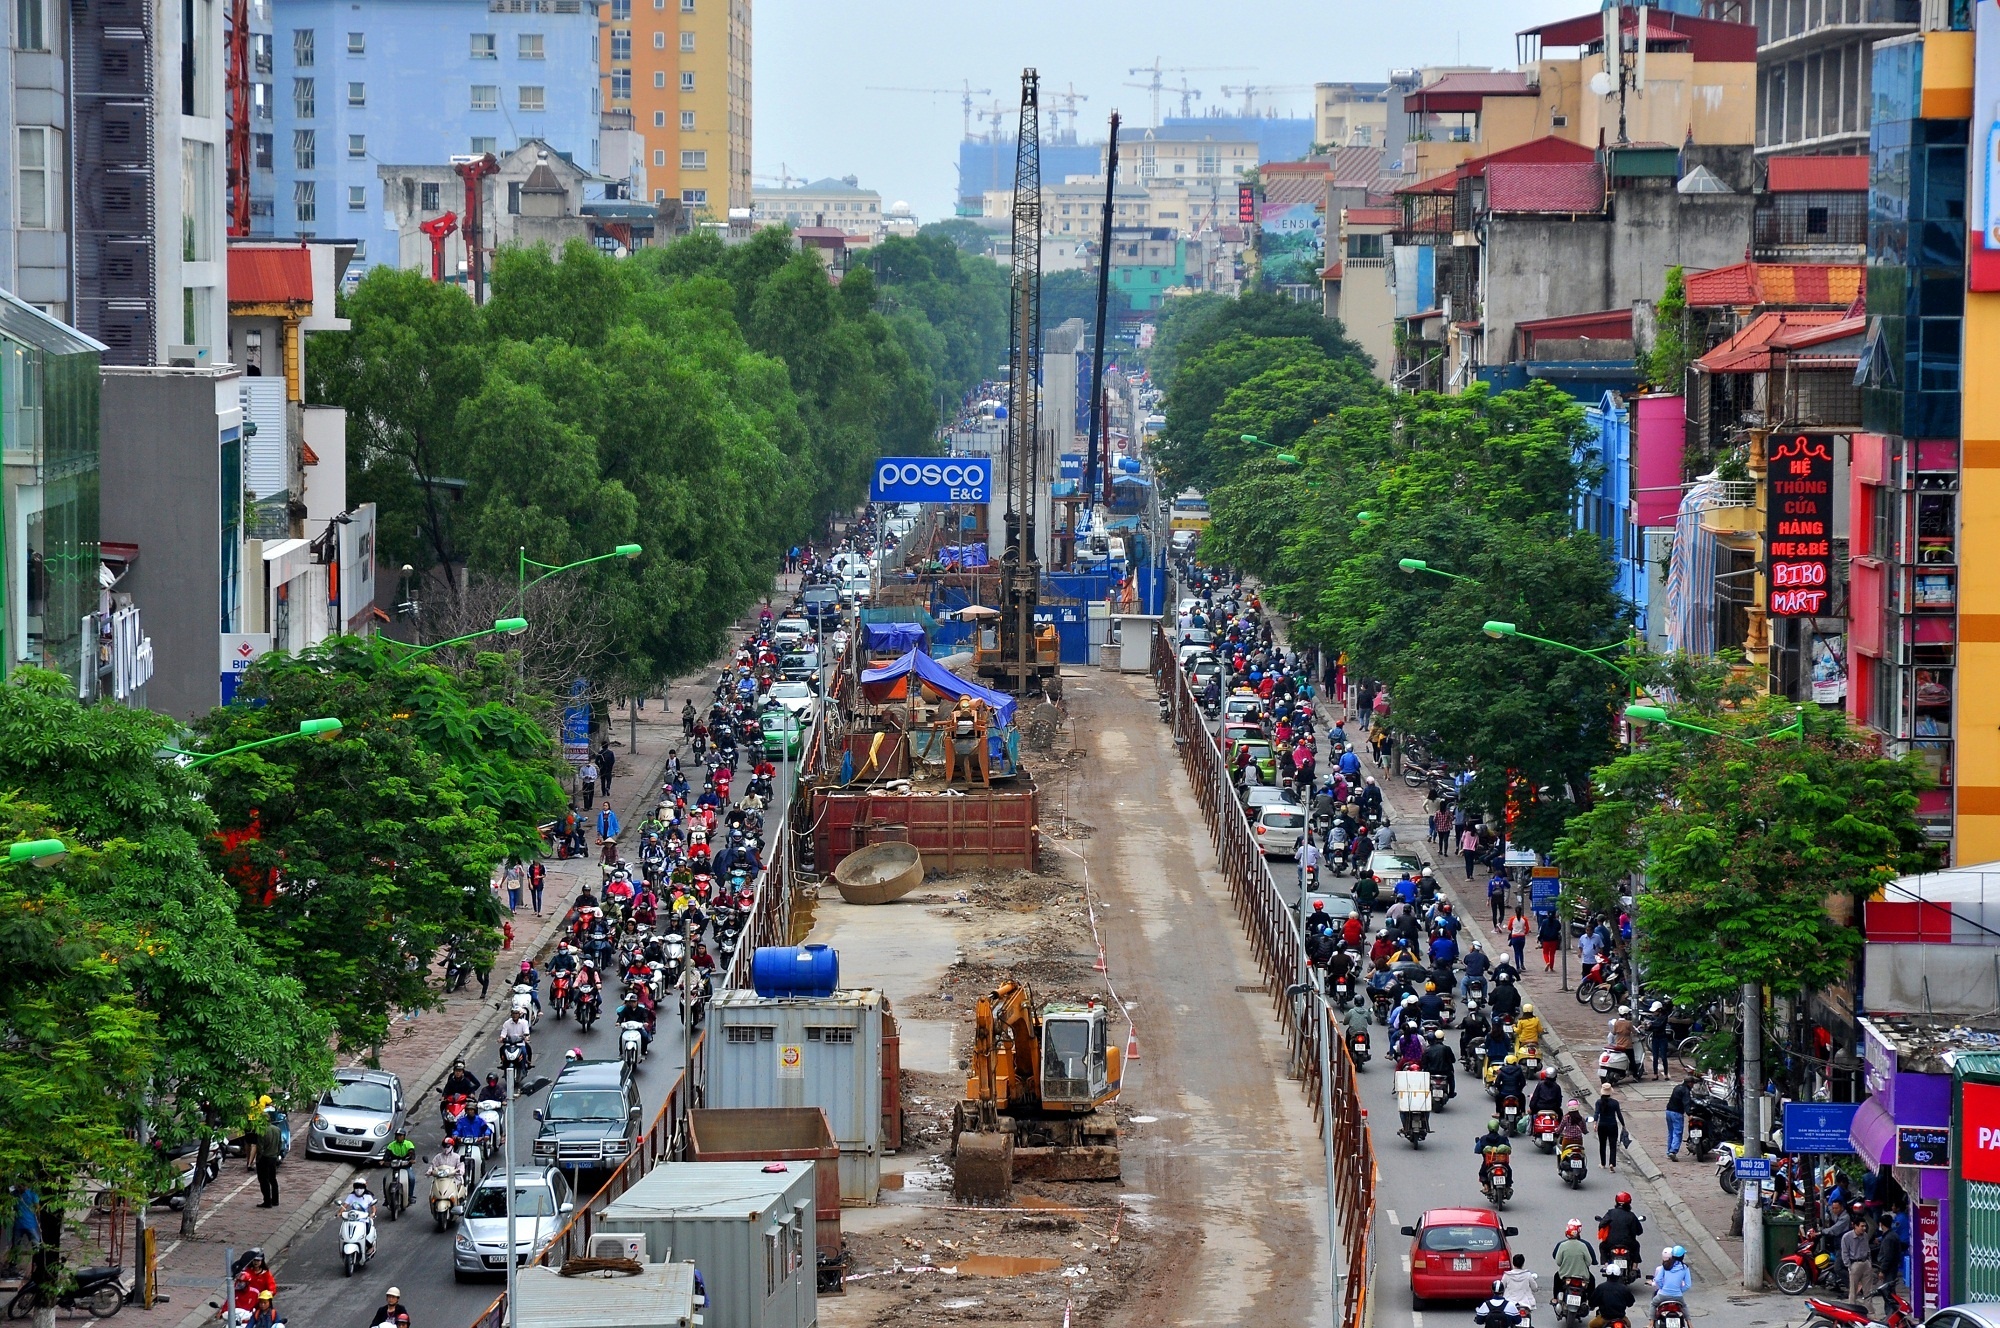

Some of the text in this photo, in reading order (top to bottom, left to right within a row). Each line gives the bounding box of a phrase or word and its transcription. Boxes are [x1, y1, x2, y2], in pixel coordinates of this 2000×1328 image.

[1275, 219, 1309, 229] SENSI
[1790, 457, 1812, 477] HỆ
[950, 487, 983, 500] E&C
[1774, 476, 1827, 494] THỐNG
[1784, 496, 1817, 514] CỬA
[1778, 518, 1823, 535] HÀNG
[1771, 540, 1829, 558] MẸ&BÉ
[1775, 563, 1825, 585] BIBO
[1773, 590, 1825, 613] MART
[232, 660, 254, 669] BID
[1753, 1161, 1765, 1169] 226
[1920, 1216, 1936, 1225] TÍCH
